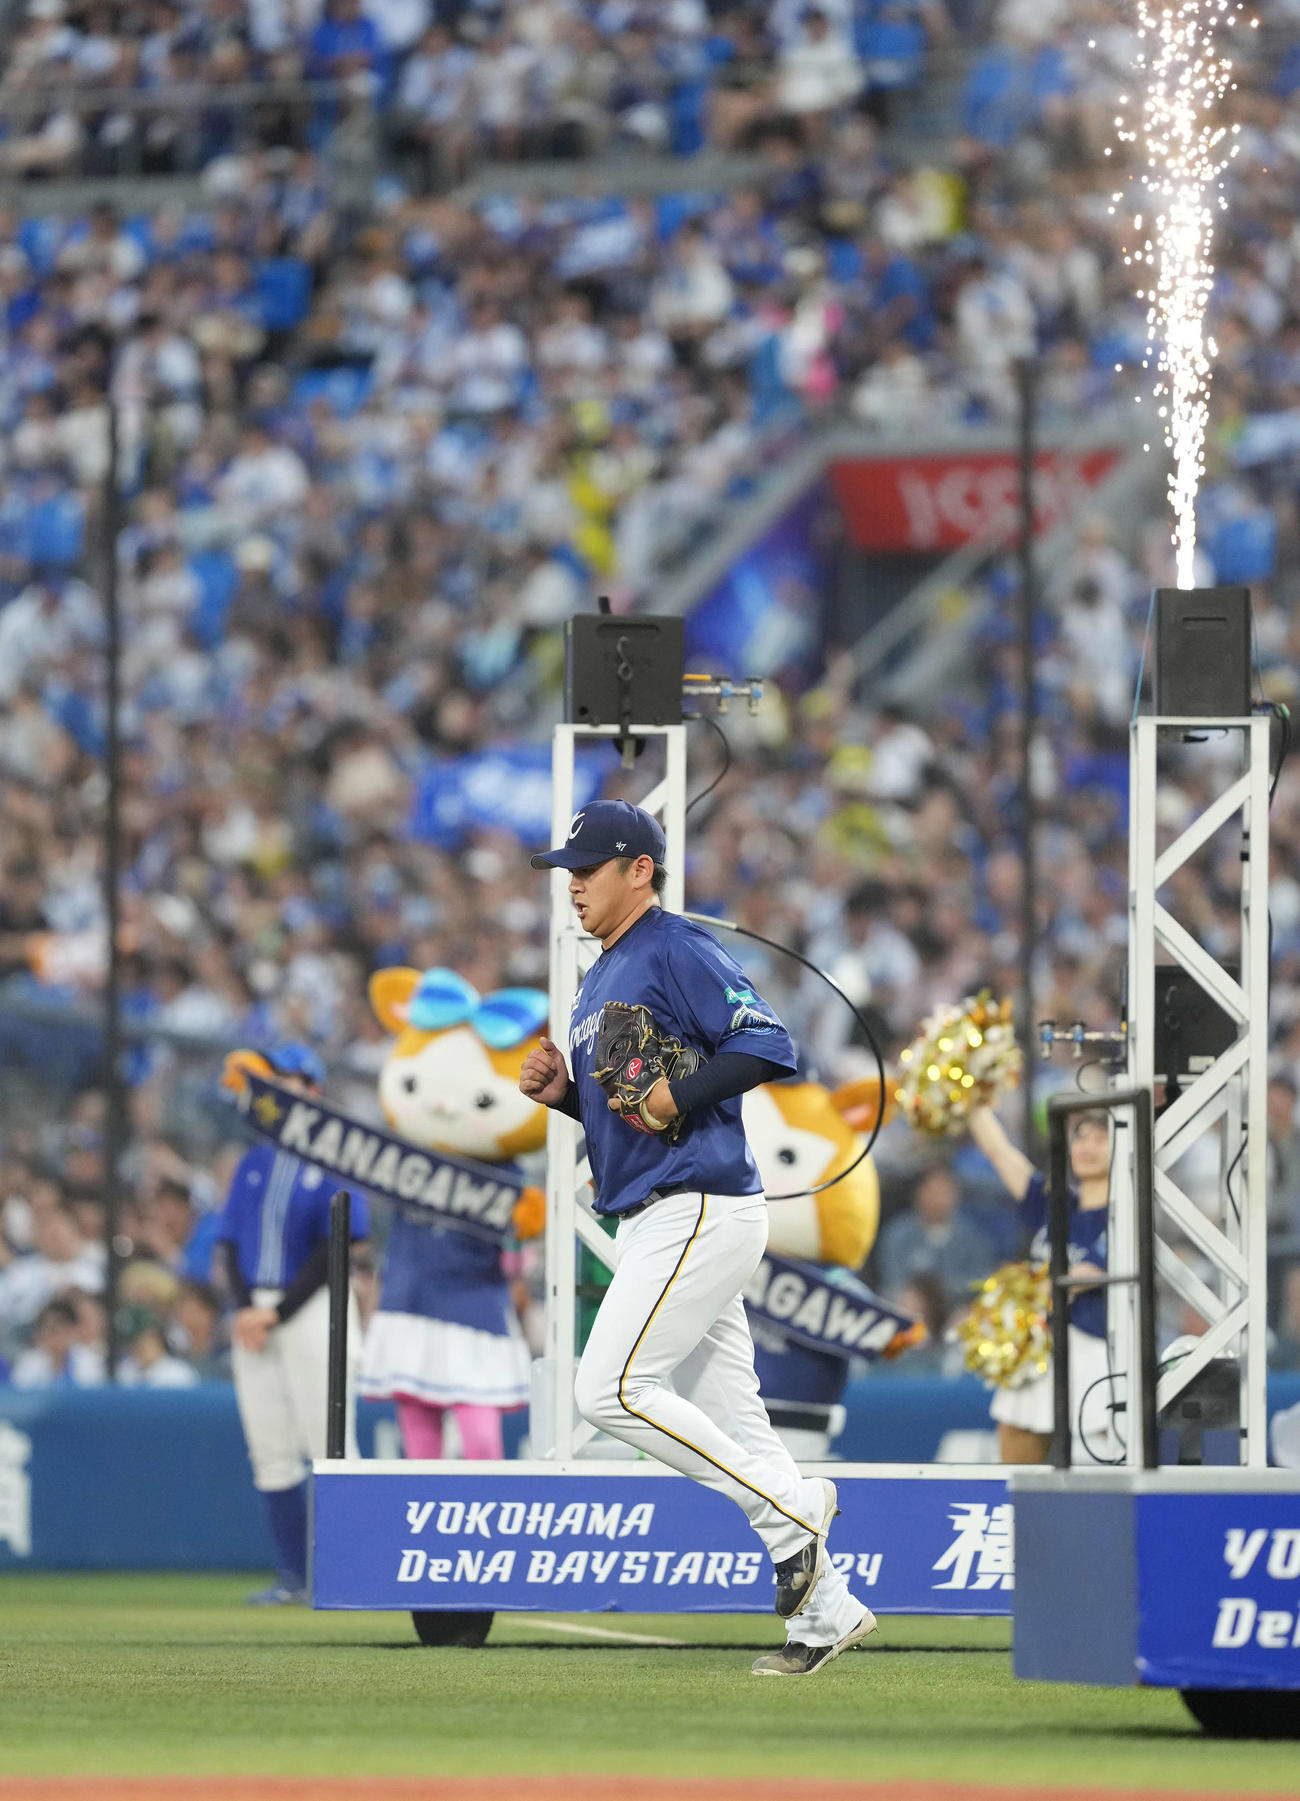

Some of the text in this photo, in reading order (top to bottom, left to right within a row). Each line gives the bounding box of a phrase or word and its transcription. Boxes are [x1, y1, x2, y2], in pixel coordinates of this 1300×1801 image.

[280, 1104, 516, 1228] KANAGAWA
[742, 1257, 899, 1350] AGAWA
[406, 1501, 656, 1541] YOKOHAMA
[396, 1549, 517, 1585] DeNA
[526, 1550, 763, 1589] BAYSTARS
[1212, 1597, 1300, 1648] De
